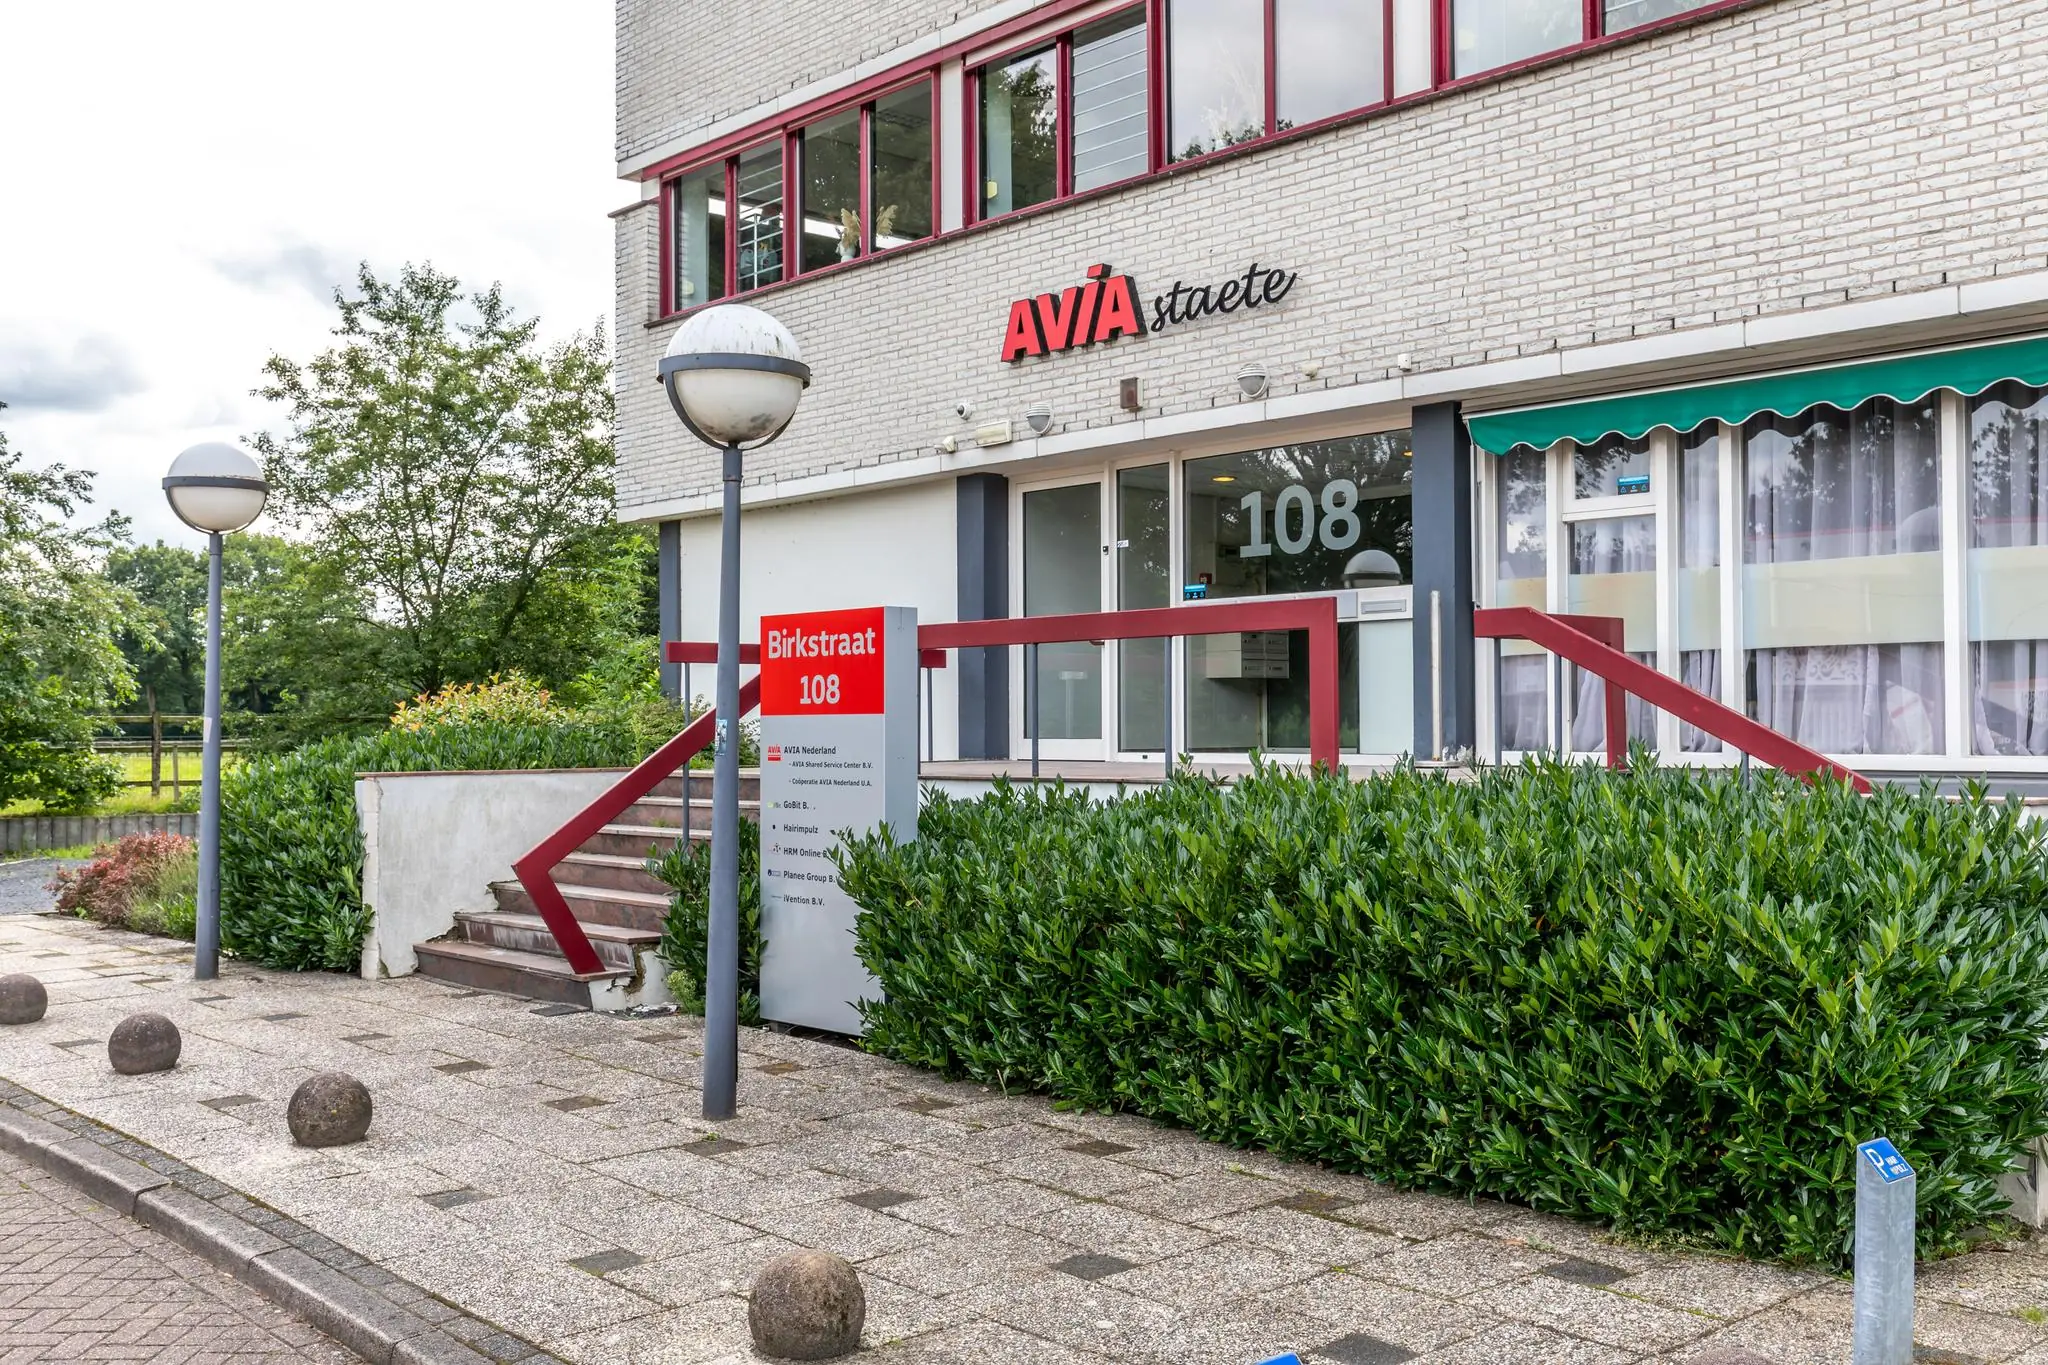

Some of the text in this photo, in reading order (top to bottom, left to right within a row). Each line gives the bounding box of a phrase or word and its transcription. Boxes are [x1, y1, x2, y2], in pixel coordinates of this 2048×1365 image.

[1150, 263, 1299, 333] staete
[1239, 479, 1361, 558] 108
[768, 628, 876, 659] Birkstraat
[800, 674, 840, 704] 108
[784, 746, 836, 755] AVIA Nederland
[833, 779, 860, 787] Nederland
[783, 801, 801, 809] GoBit
[783, 824, 818, 835] Hairimpulz
[783, 847, 798, 856] HRM
[800, 848, 821, 858] Online
[783, 870, 805, 880] Planee
[806, 873, 827, 883] Group
[783, 894, 825, 906] iVention B.V.
[1865, 1148, 1889, 1178] P
